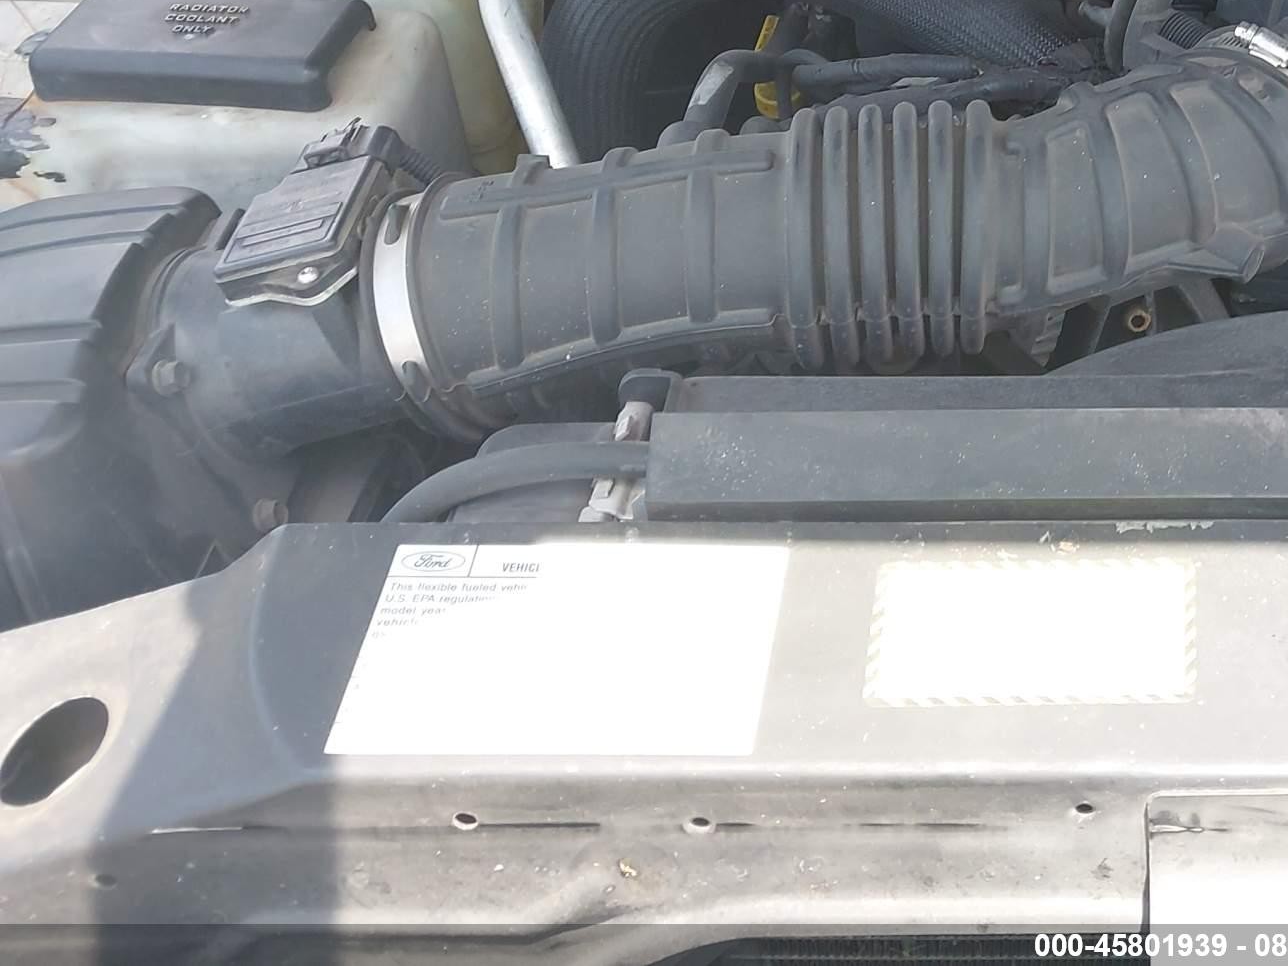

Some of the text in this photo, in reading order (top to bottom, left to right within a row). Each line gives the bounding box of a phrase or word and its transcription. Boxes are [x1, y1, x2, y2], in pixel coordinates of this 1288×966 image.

[169, 3, 249, 13] RADIATOR
[164, 13, 239, 24] COOLANT
[171, 24, 212, 33] ONLY
[414, 554, 452, 568] Ford
[390, 583, 413, 592] This
[417, 583, 457, 592] flexible
[461, 583, 497, 592] fueled
[412, 594, 435, 603] EPA
[380, 607, 416, 615] model
